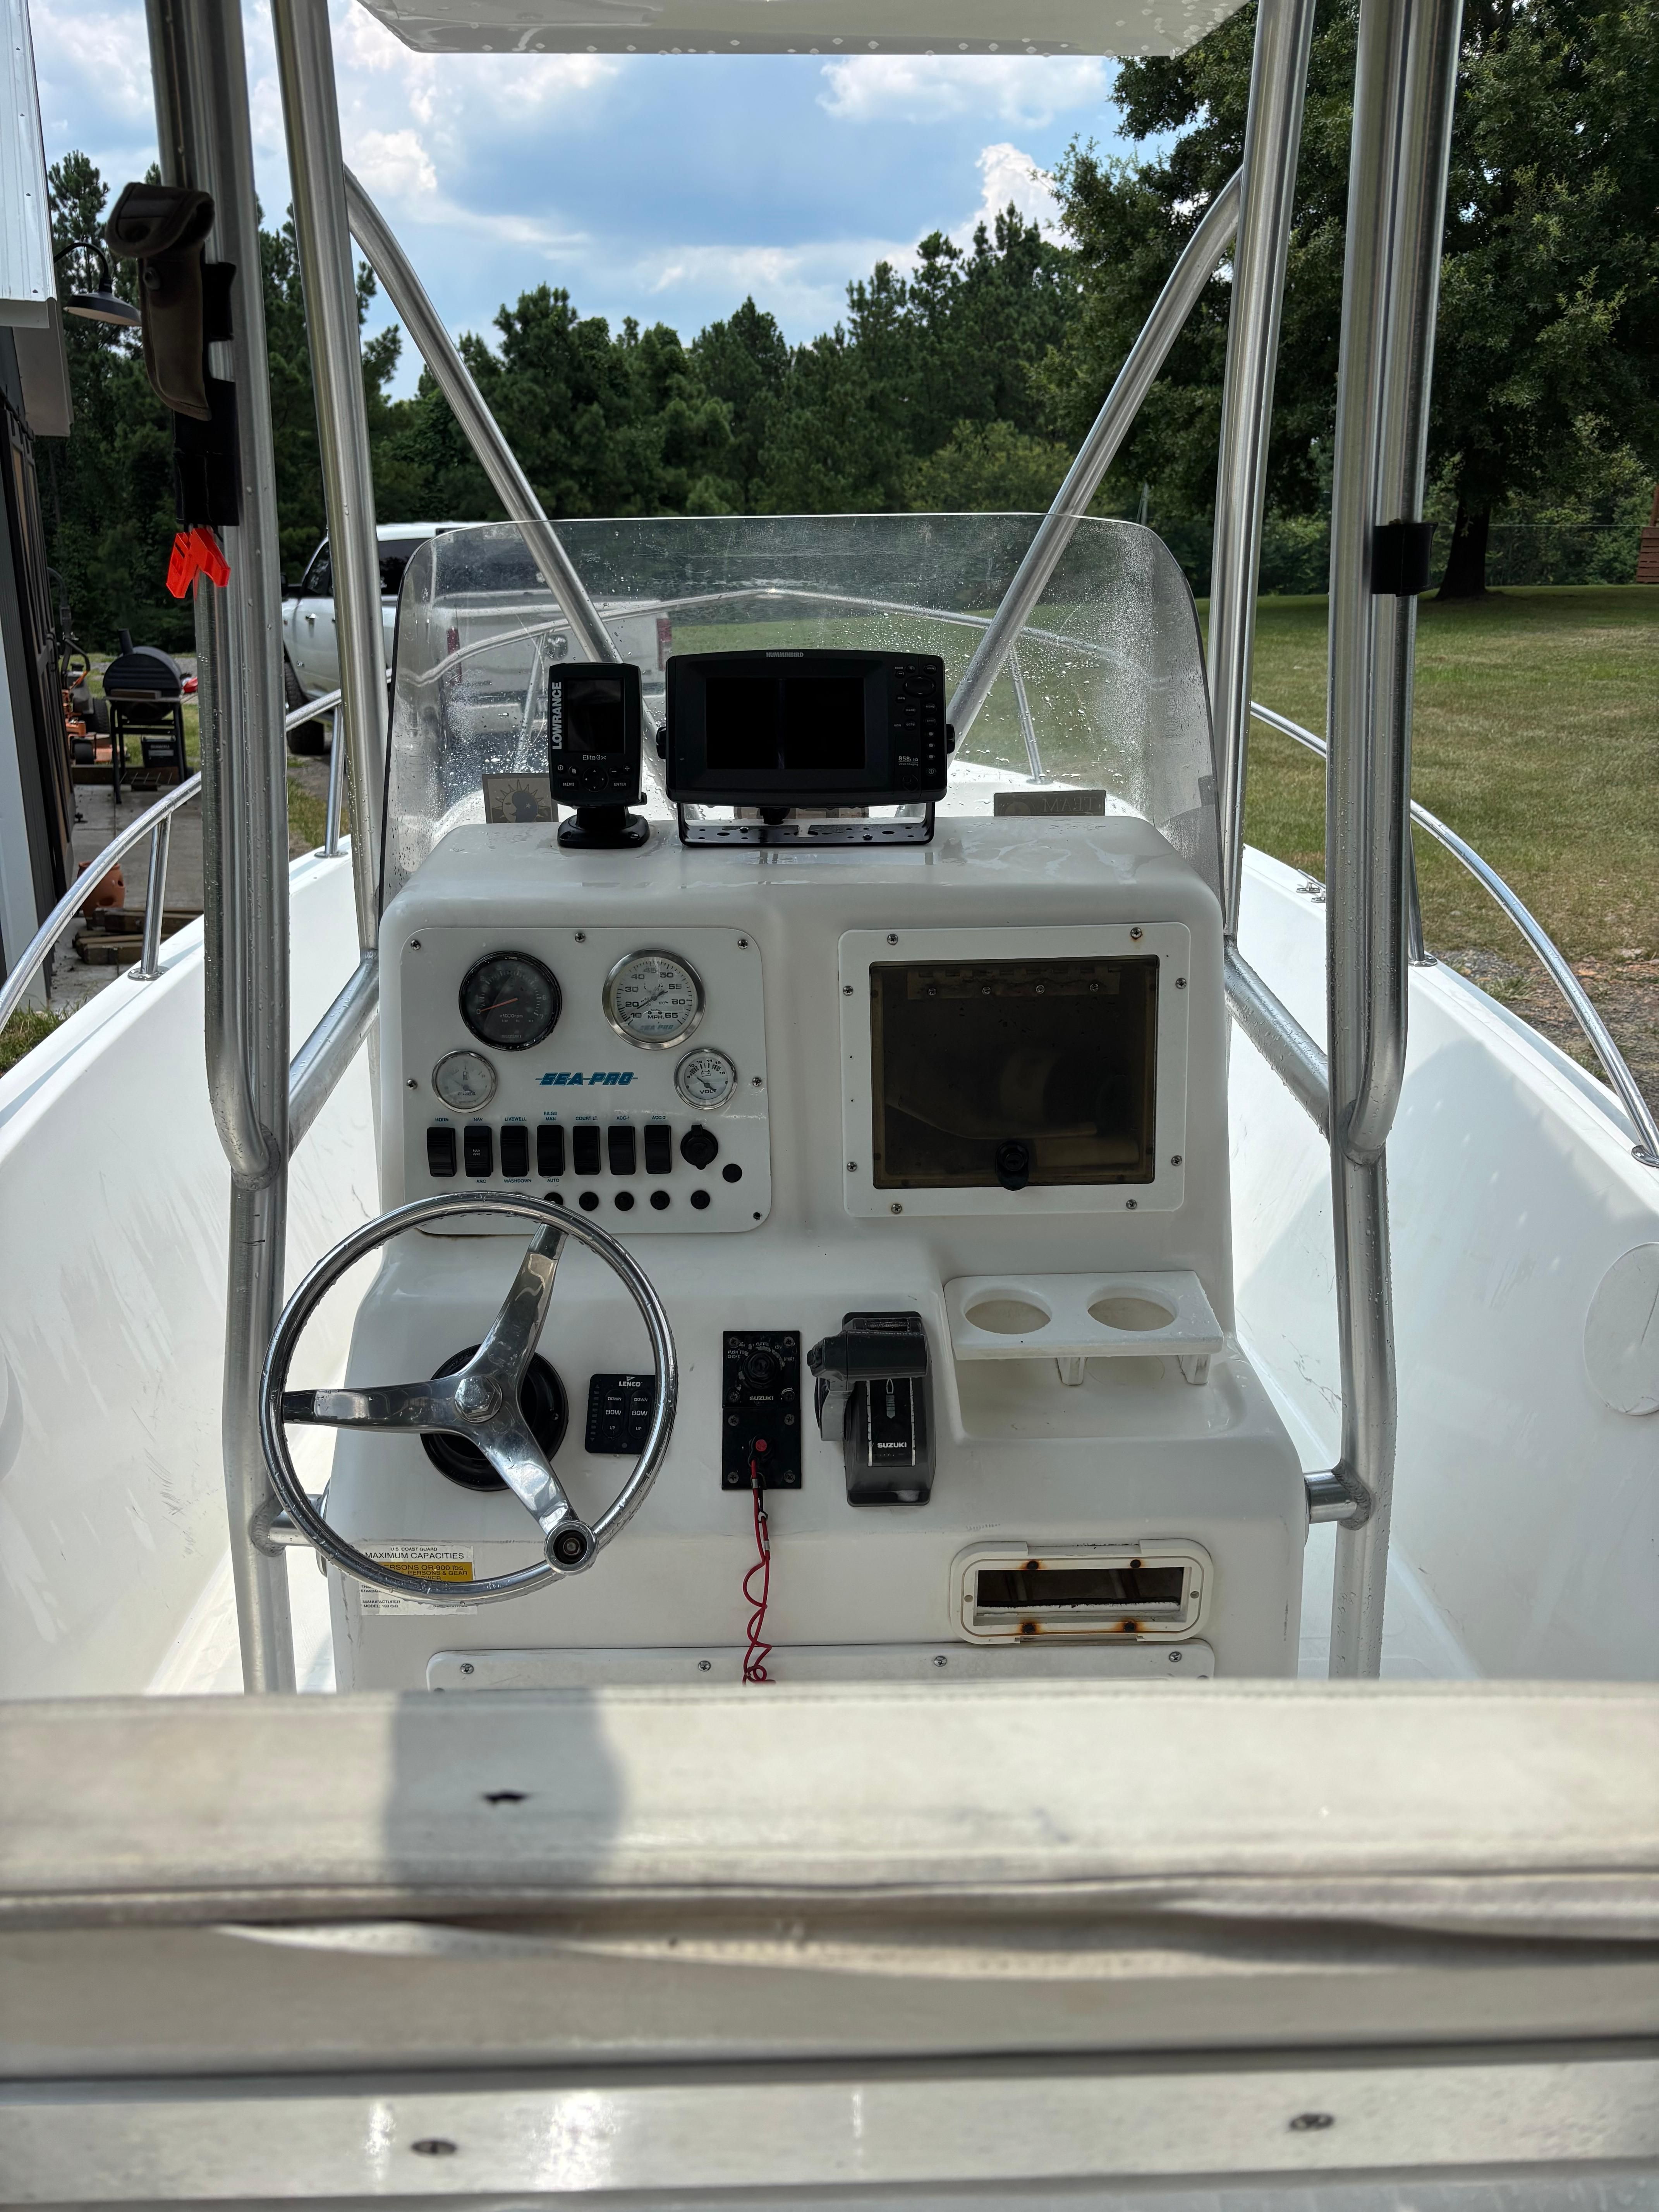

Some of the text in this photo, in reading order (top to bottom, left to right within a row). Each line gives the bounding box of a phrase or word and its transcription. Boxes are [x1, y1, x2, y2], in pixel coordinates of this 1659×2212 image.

[552, 682, 562, 750] LOWRANCE
[539, 1072, 634, 1085] SEA PRO
